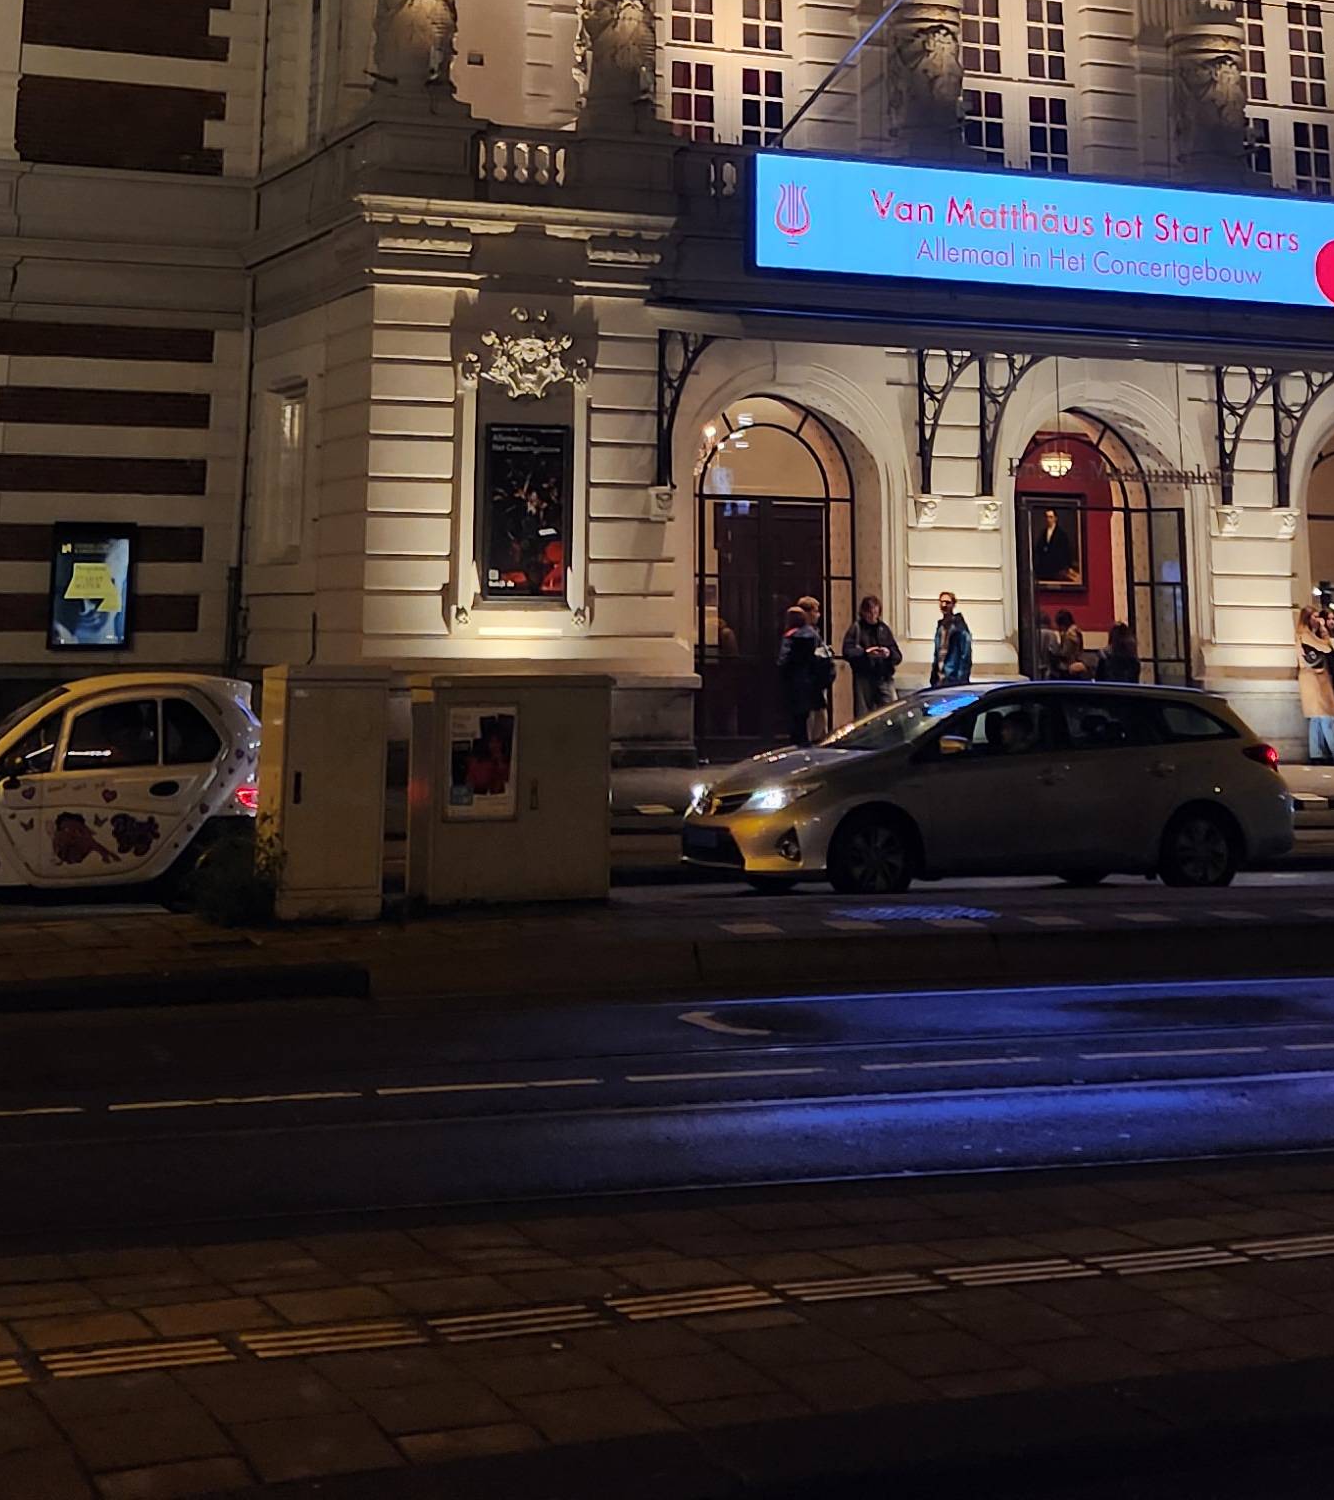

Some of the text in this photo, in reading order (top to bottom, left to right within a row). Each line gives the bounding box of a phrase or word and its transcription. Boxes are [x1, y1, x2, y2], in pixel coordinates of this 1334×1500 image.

[870, 189, 1300, 252] Van Matthäus tot Star Wars
[916, 236, 1263, 287] Allemaal in Het Concertgebouw
